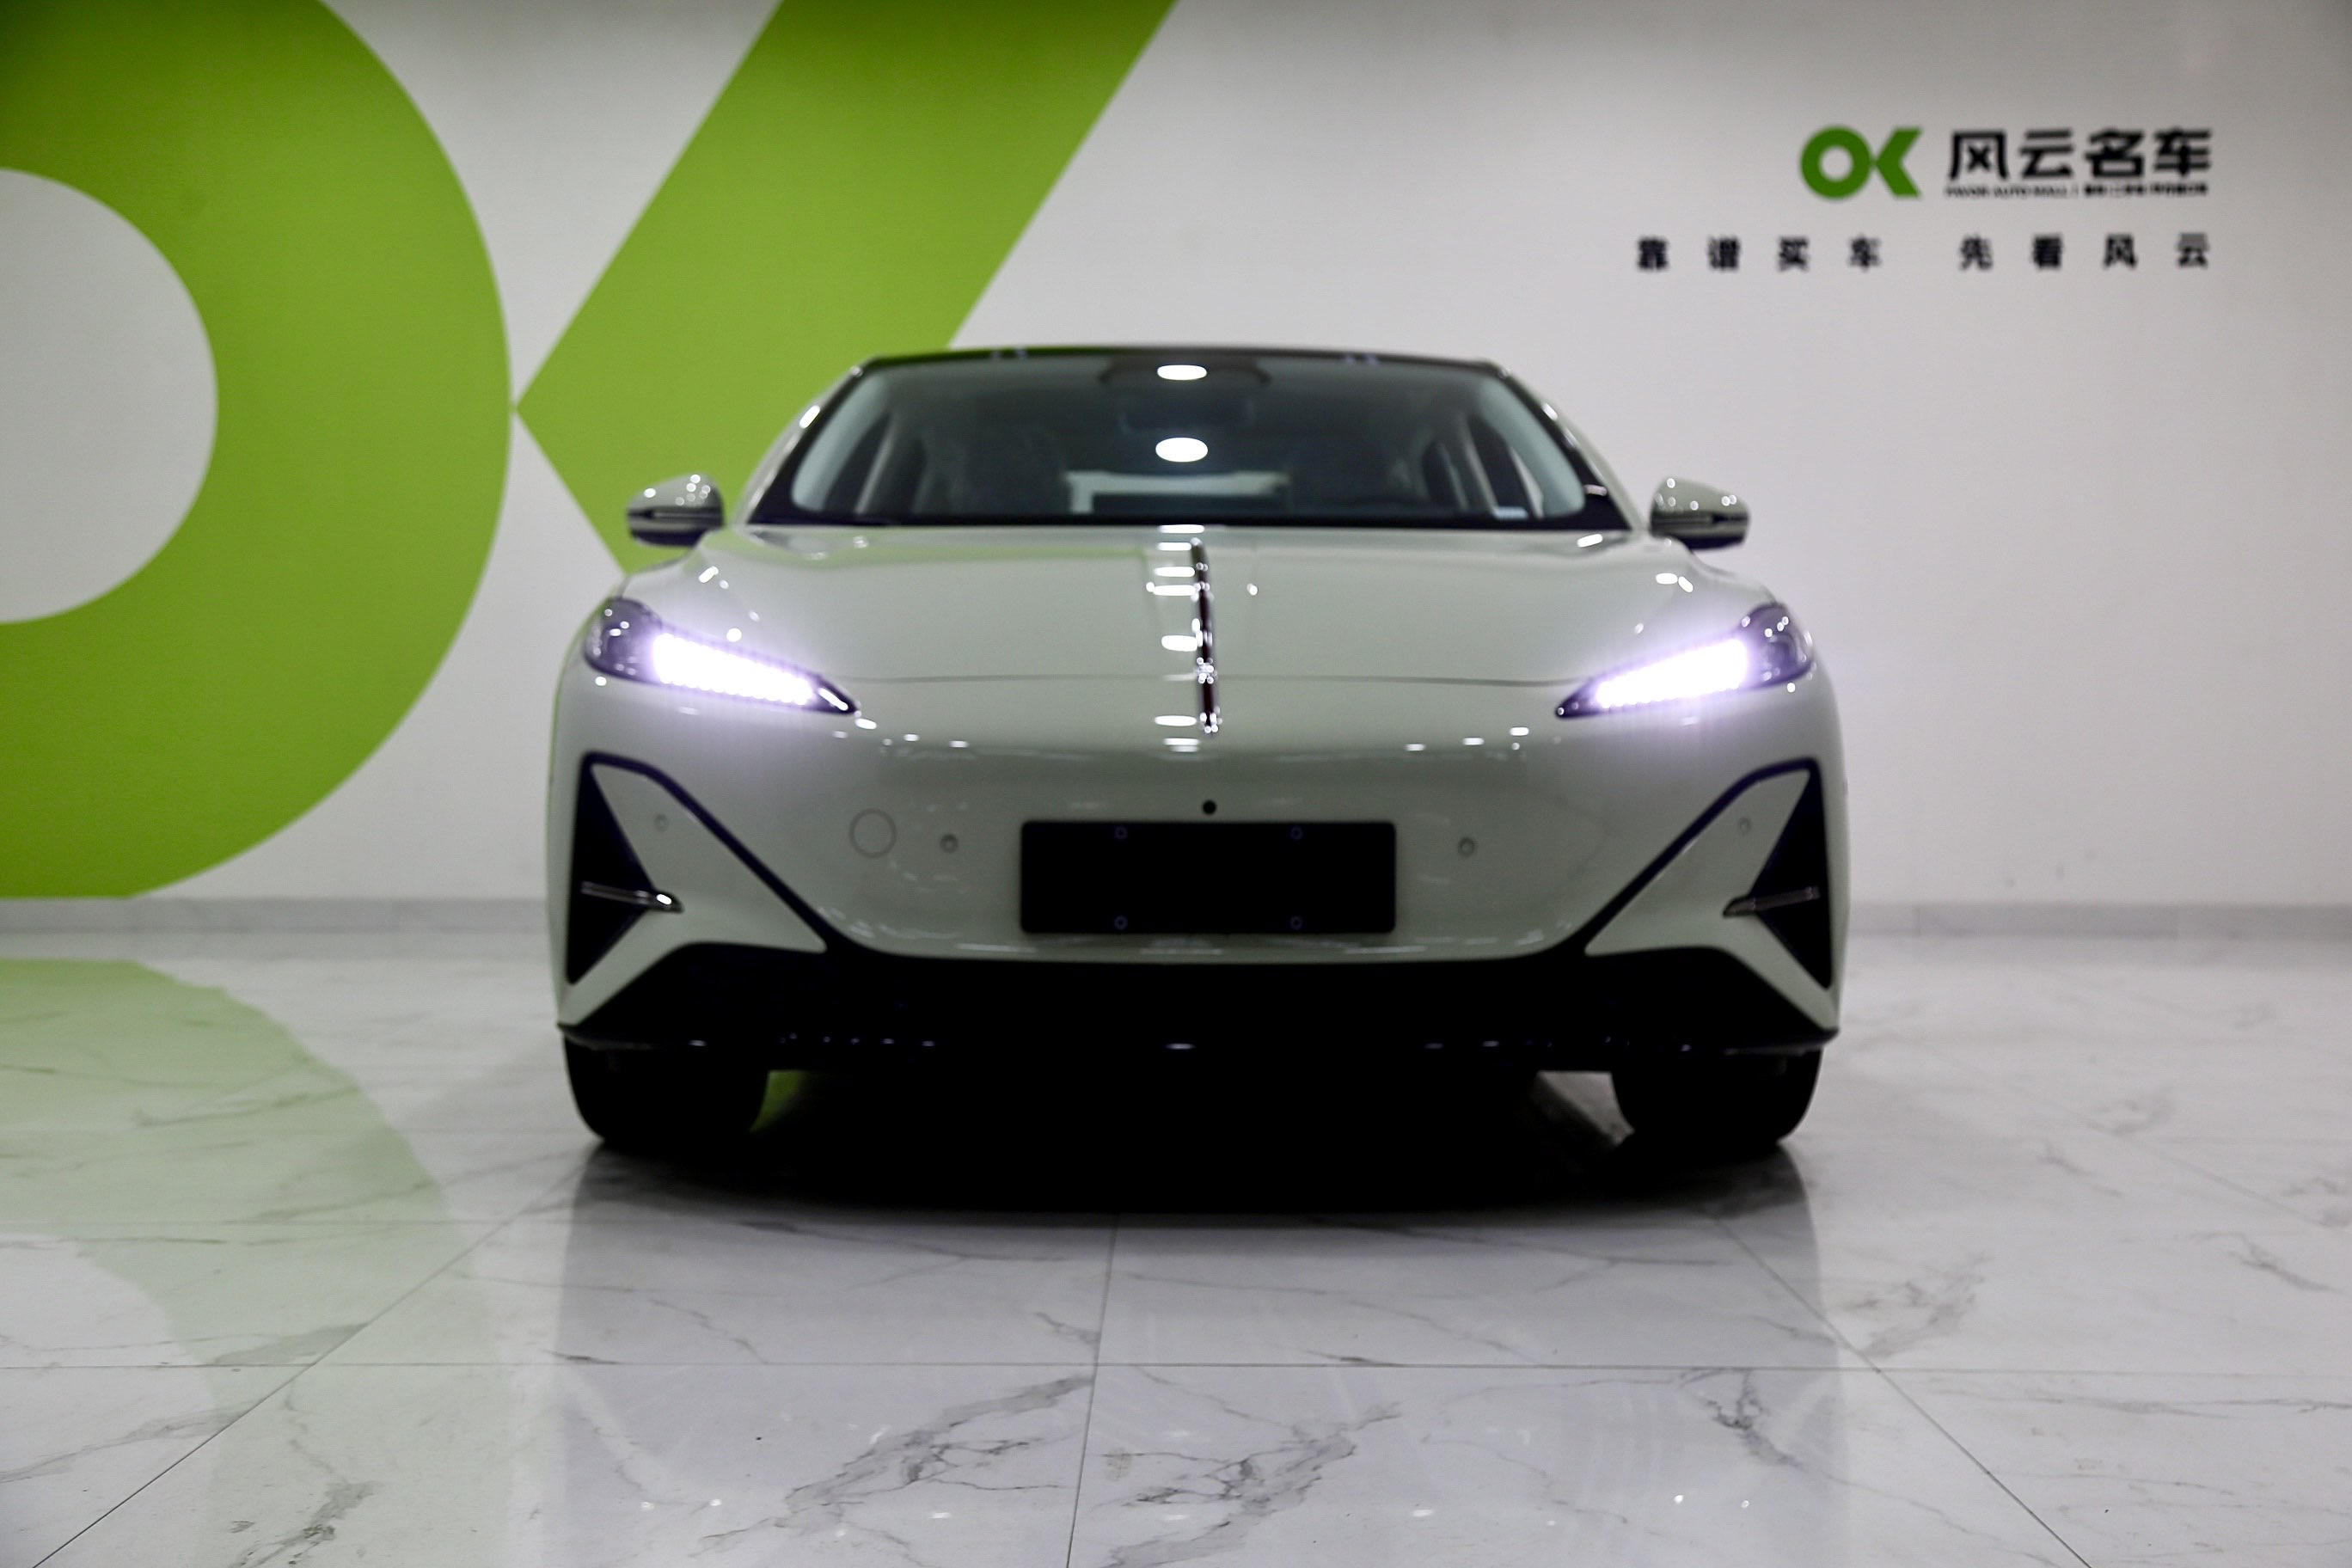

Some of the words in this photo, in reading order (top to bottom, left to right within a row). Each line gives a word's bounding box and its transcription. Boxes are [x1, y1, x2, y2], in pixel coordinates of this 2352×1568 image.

[1799, 126, 1922, 200] OK
[1947, 126, 2213, 181] 风云名车
[1638, 236, 1879, 272] 靠谱买车
[1960, 233, 2209, 271] 先看风云
